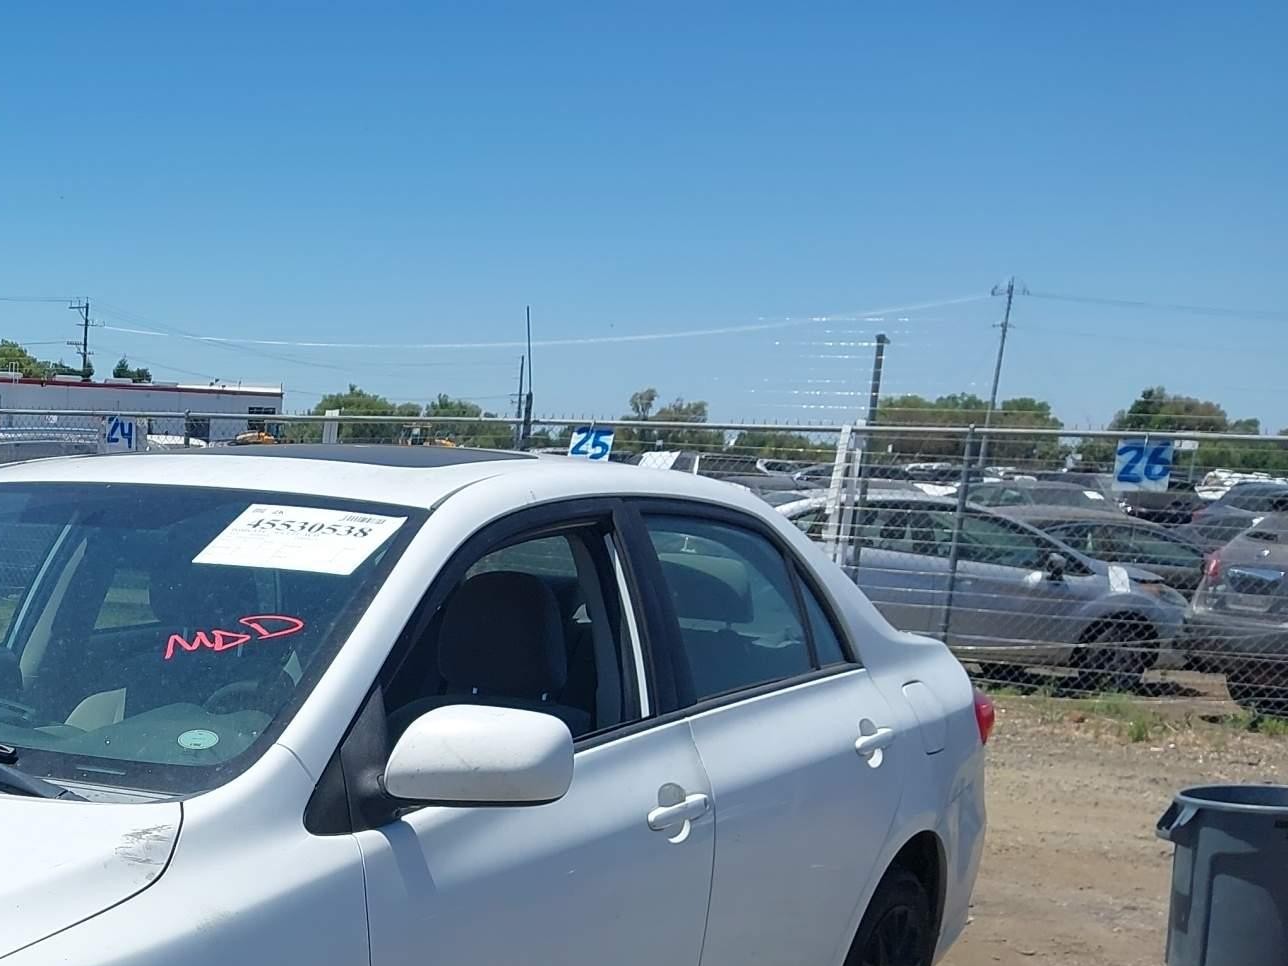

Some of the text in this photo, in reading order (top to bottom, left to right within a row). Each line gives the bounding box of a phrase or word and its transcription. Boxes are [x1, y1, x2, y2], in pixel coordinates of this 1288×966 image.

[107, 417, 132, 449] 24
[571, 427, 613, 460] 25
[1117, 442, 1171, 483] 26
[247, 518, 372, 538] 45530538
